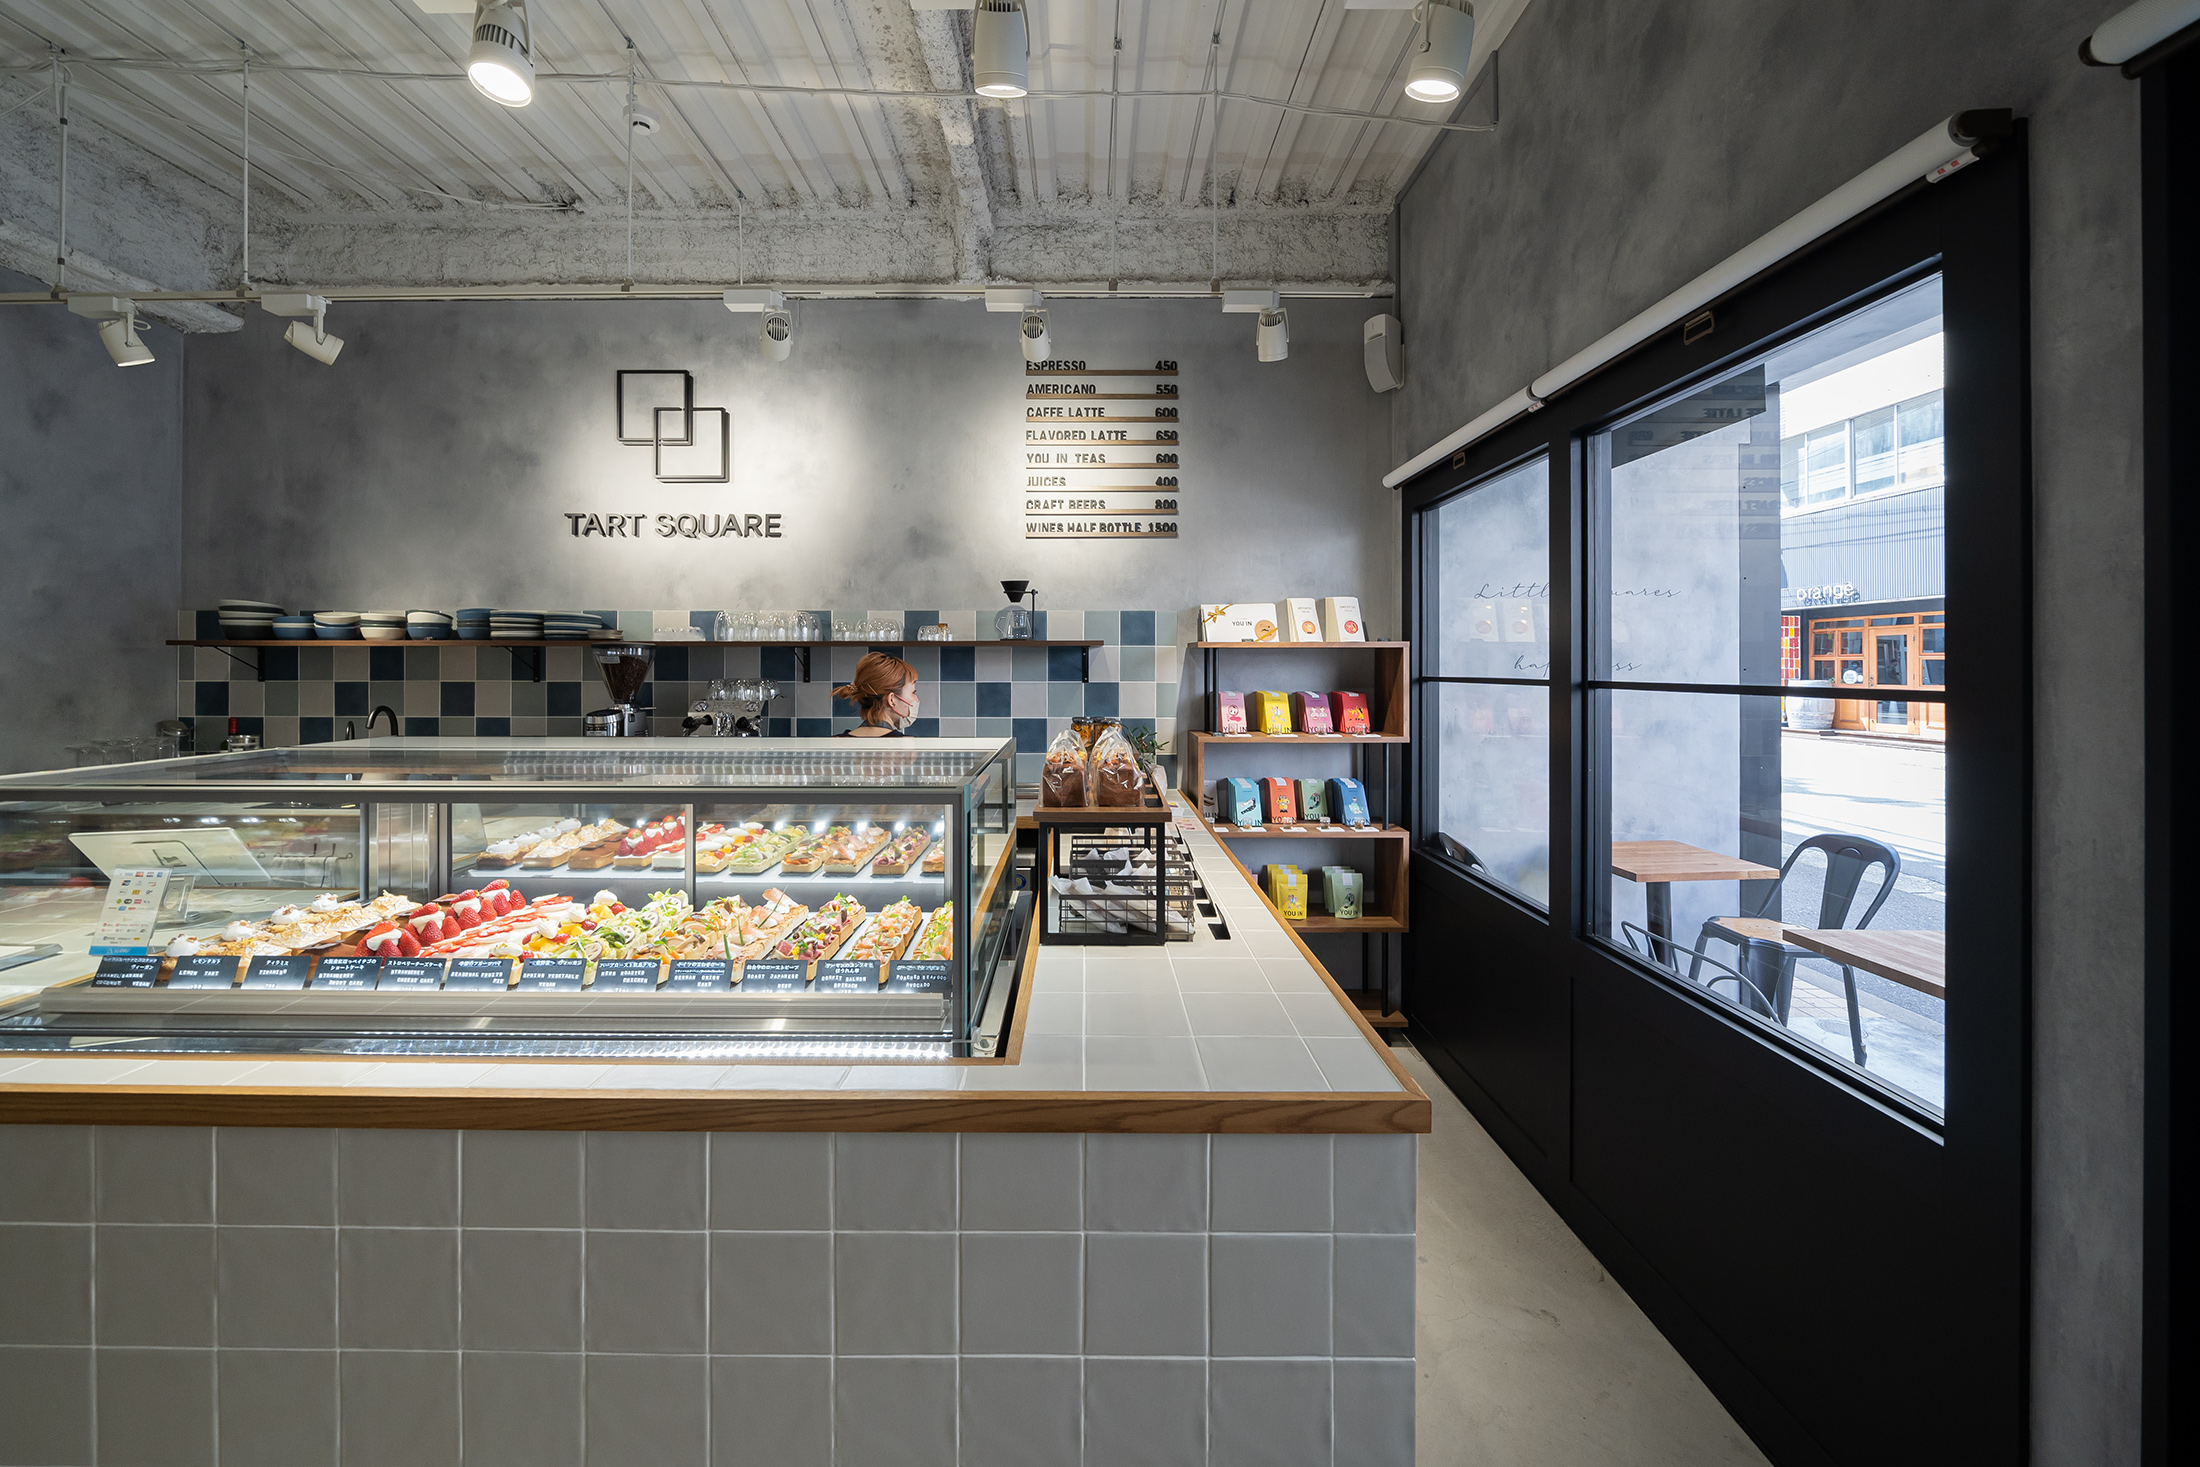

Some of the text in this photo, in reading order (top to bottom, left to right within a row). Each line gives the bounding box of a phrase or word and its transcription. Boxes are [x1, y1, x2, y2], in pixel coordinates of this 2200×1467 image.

[1026, 361, 1178, 371] ESPRESSO 450
[1027, 384, 1178, 394] AMERICANO 550
[1026, 407, 1178, 417] CAFFE LATTE 600
[1026, 430, 1178, 440] FLAVORED LATTE 650
[1026, 453, 1178, 463] YOU IN TEAS 600
[1026, 476, 1178, 486] JUICES 400
[1026, 500, 1178, 509] CRAFT BEERS 800
[564, 513, 783, 538] TART SQUARE
[1026, 522, 1064, 532] WINES
[1067, 522, 1096, 532] HALF
[1099, 522, 1142, 532] BOTTLE
[1474, 582, 1549, 599] Littl
